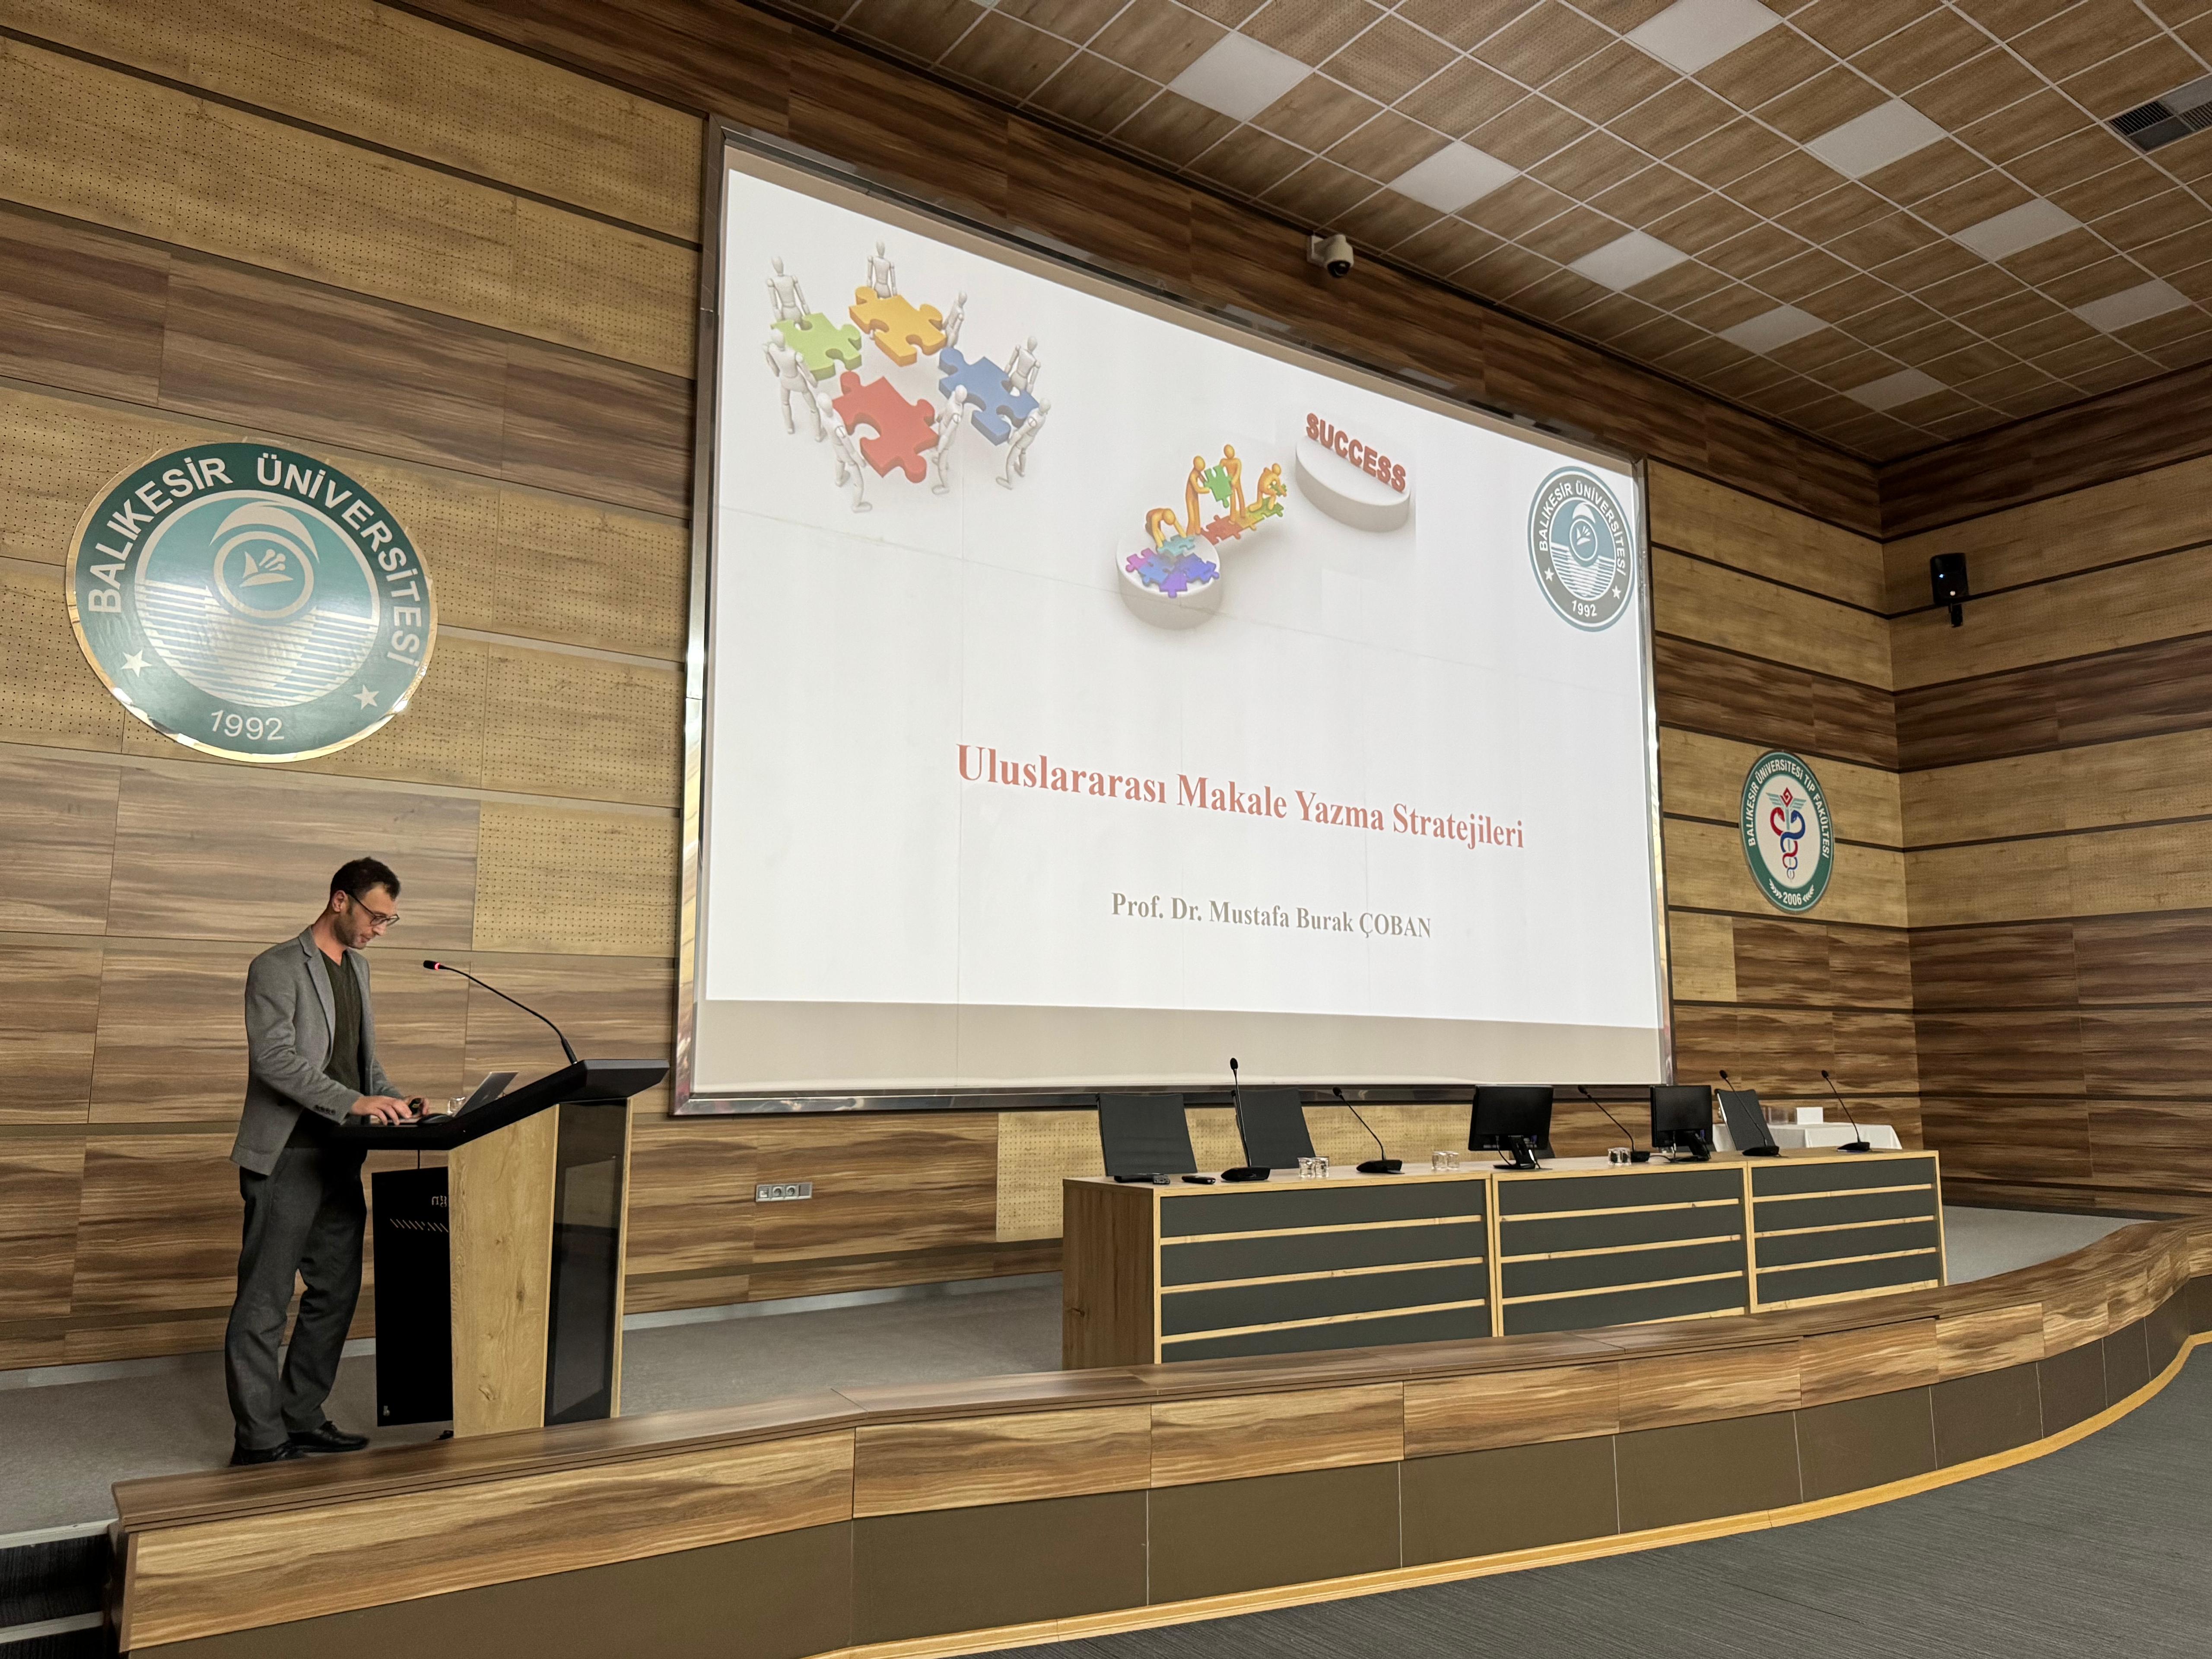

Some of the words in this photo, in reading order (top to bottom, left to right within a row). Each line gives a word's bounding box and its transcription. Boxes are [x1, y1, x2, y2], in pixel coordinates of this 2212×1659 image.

[1306, 413, 1406, 493] SUCCESS
[89, 457, 232, 613] BALIKESİR
[258, 453, 422, 667] ÜNİVERSİTESİ
[1572, 600, 1597, 617] 1992
[211, 709, 285, 741] 1992
[957, 744, 1167, 804] Uluslararası
[1177, 774, 1287, 819] Makale
[1295, 791, 1385, 831] Yazma
[1393, 804, 1524, 850] Stratejileri
[1804, 774, 1815, 792] TIP
[1112, 893, 1164, 919] Prof.
[1171, 898, 1202, 922] Dr.
[1210, 900, 1290, 928] Mustafa
[1296, 908, 1354, 933] Burak
[1359, 913, 1431, 939] ÇOBAN
[1783, 892, 1802, 906] 2006
